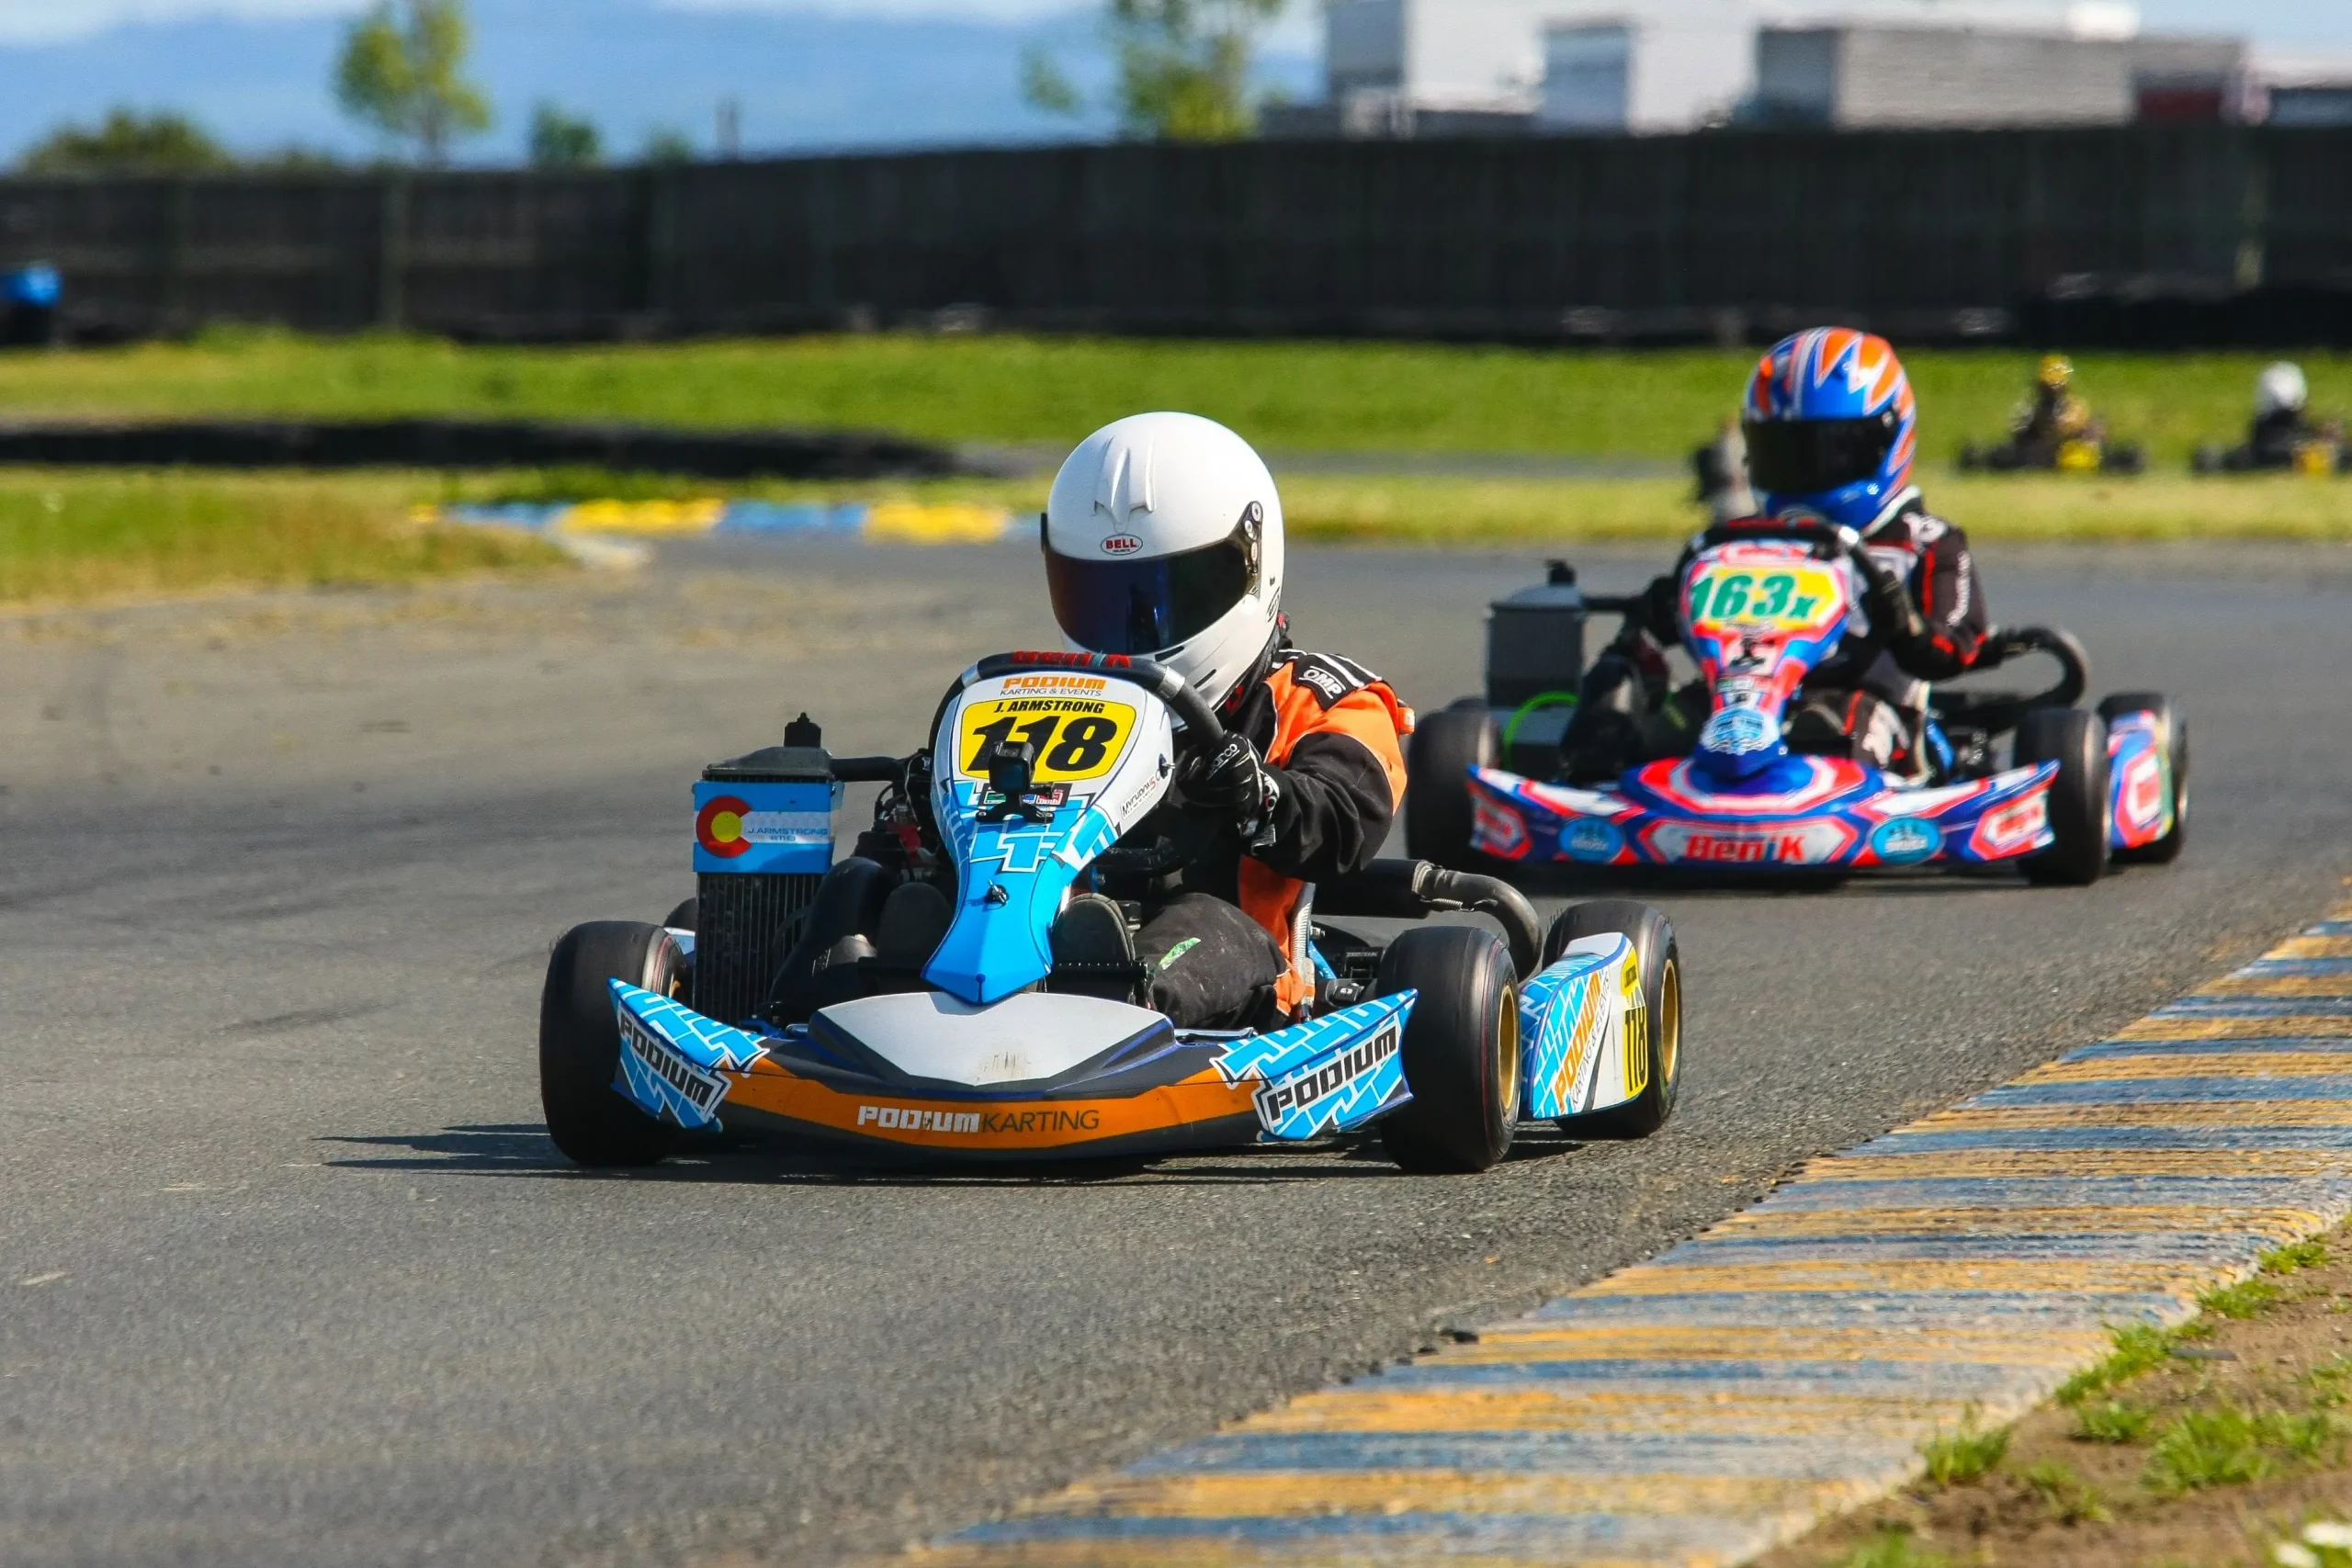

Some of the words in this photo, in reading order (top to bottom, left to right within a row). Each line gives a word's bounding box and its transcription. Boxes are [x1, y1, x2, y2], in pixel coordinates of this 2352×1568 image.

[1105, 538, 1137, 549] BELL
[1000, 688, 1046, 696] KARTING
[1060, 688, 1102, 696] EVENTS
[1003, 676, 1106, 690] PODIUM
[1303, 669, 1342, 694] OMP
[993, 701, 1004, 714] J.
[1007, 700, 1105, 714] ARMSTRONG
[966, 716, 1118, 772] 118
[620, 1011, 716, 1108] PODIUM
[1555, 971, 1601, 1114] PODIUM
[1624, 989, 1647, 1092] 118
[1267, 1025, 1396, 1122] PODIUM
